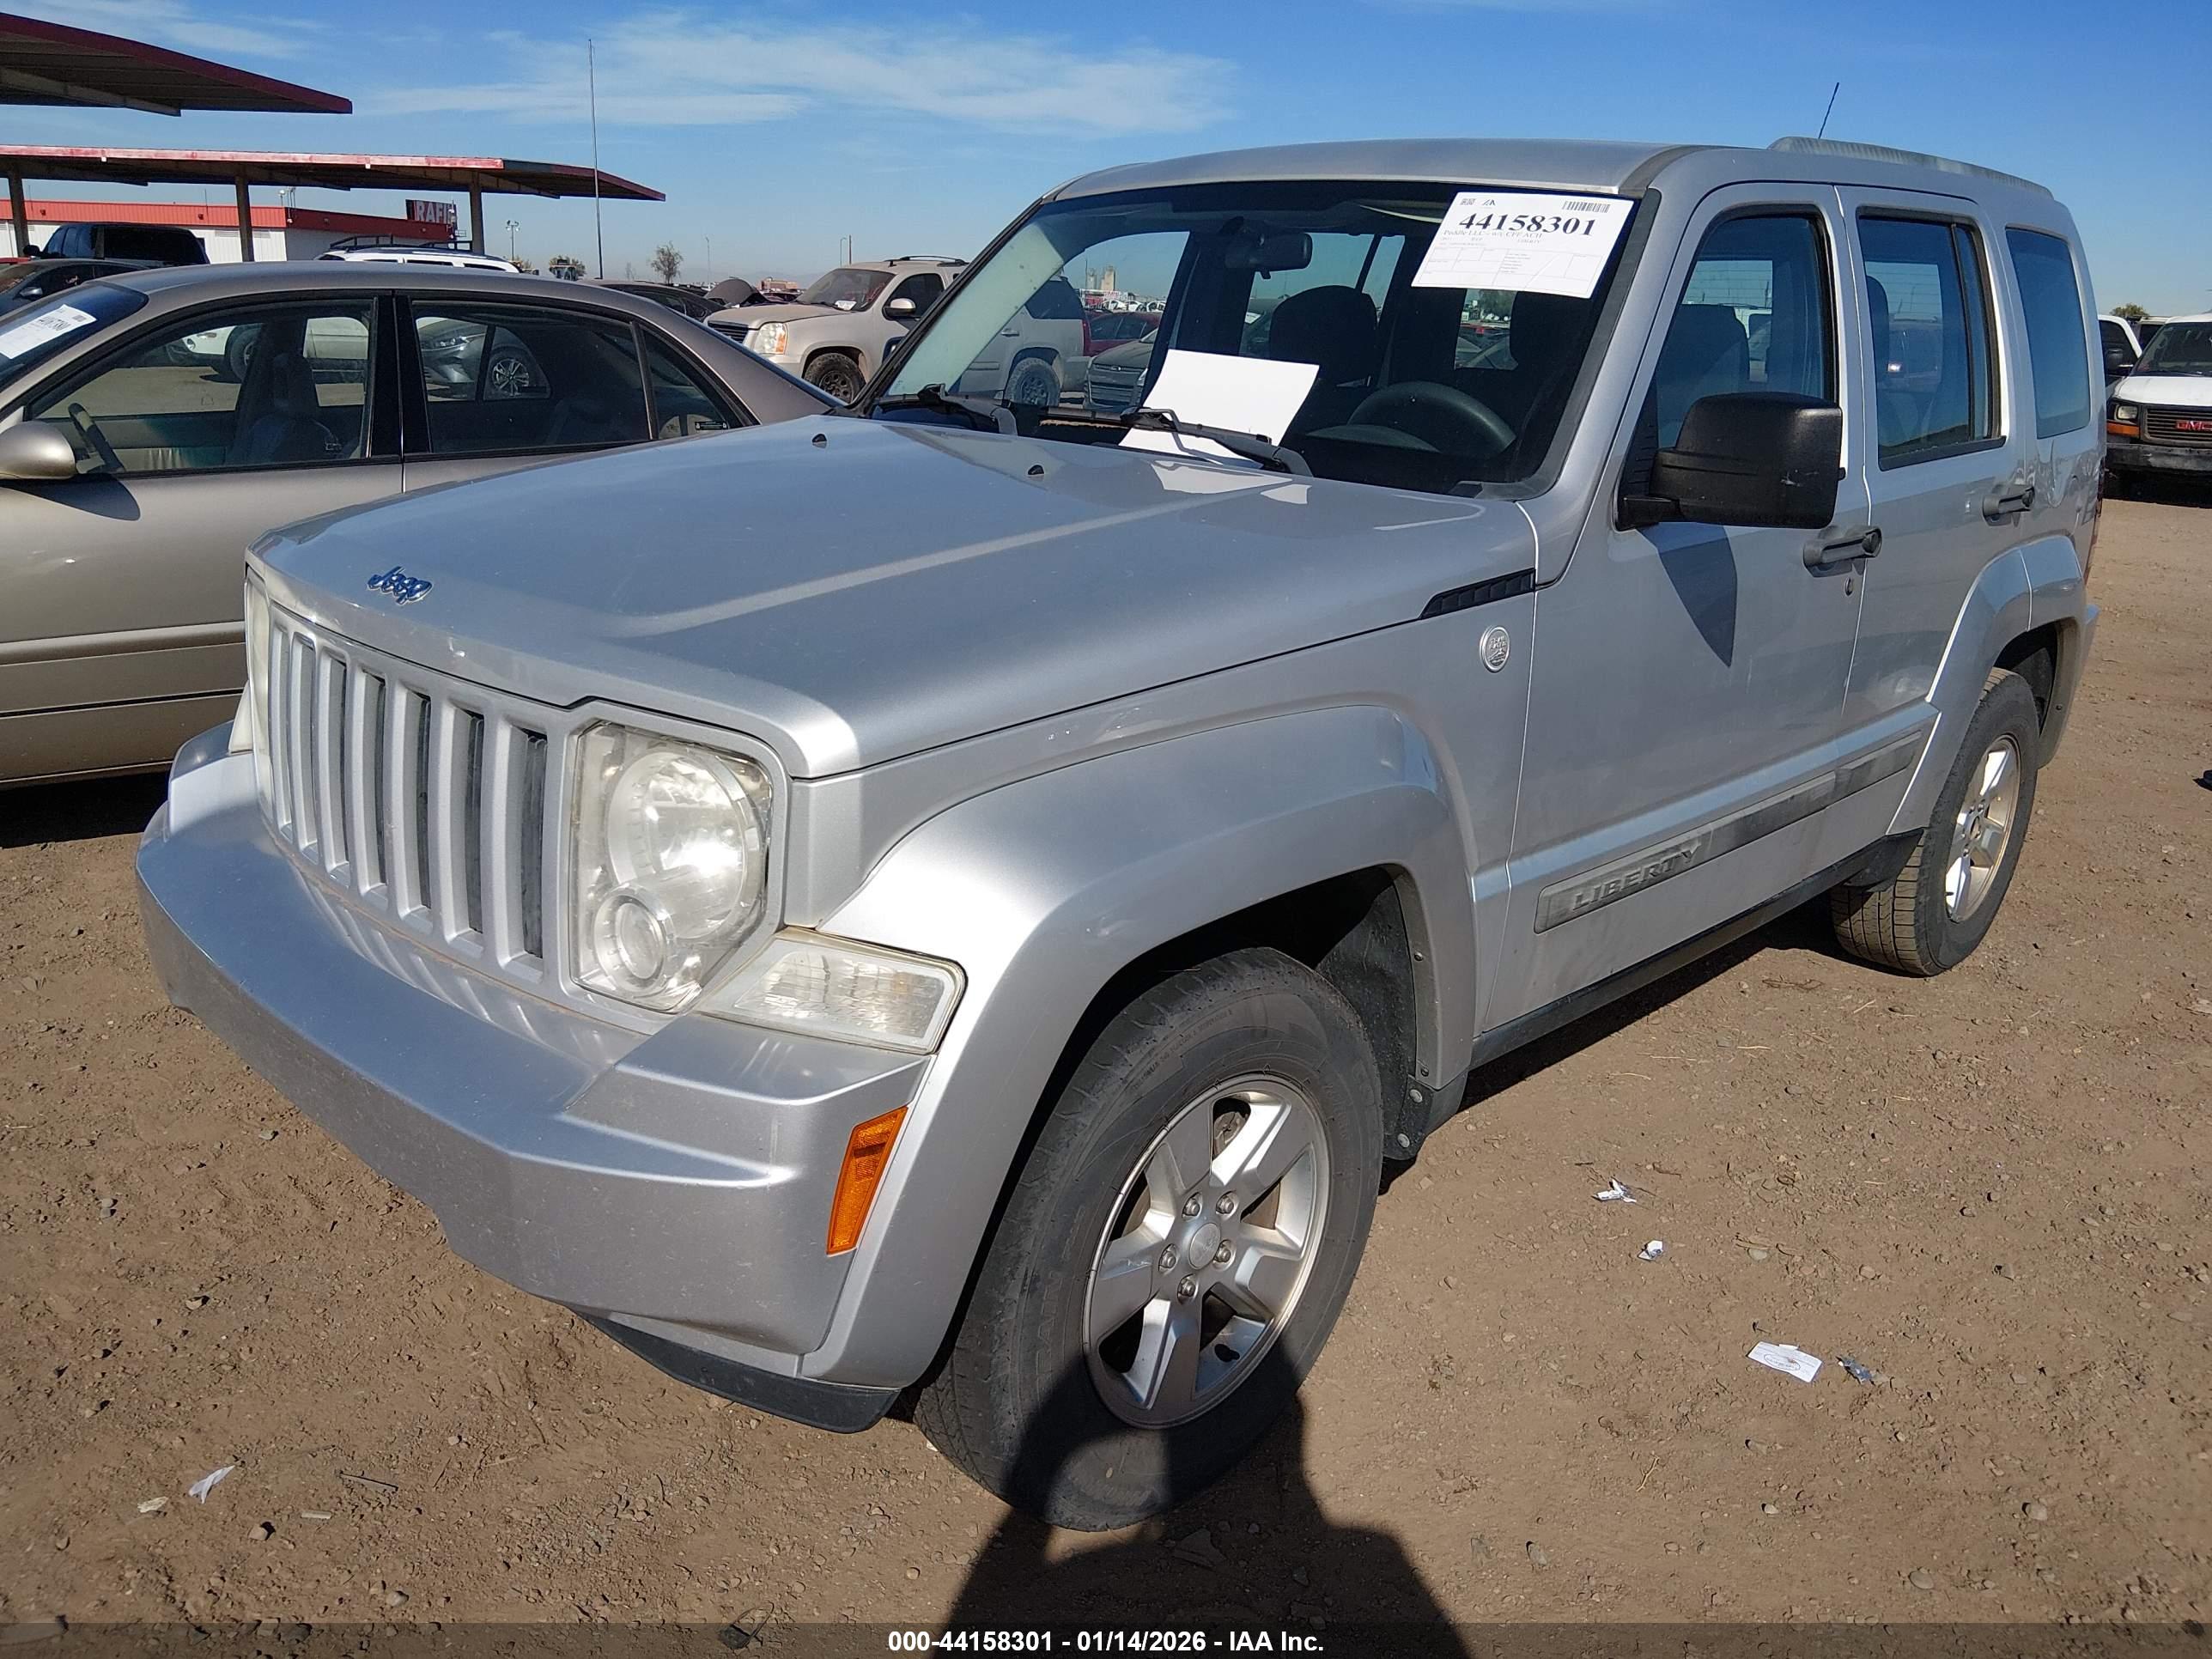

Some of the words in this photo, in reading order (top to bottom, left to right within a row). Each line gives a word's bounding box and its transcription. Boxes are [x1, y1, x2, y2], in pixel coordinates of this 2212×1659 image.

[1458, 212, 1595, 236] 44158301
[2176, 420, 2212, 431] GMC
[367, 566, 433, 605] Jeep
[1572, 843, 1701, 910] LIBERTY
